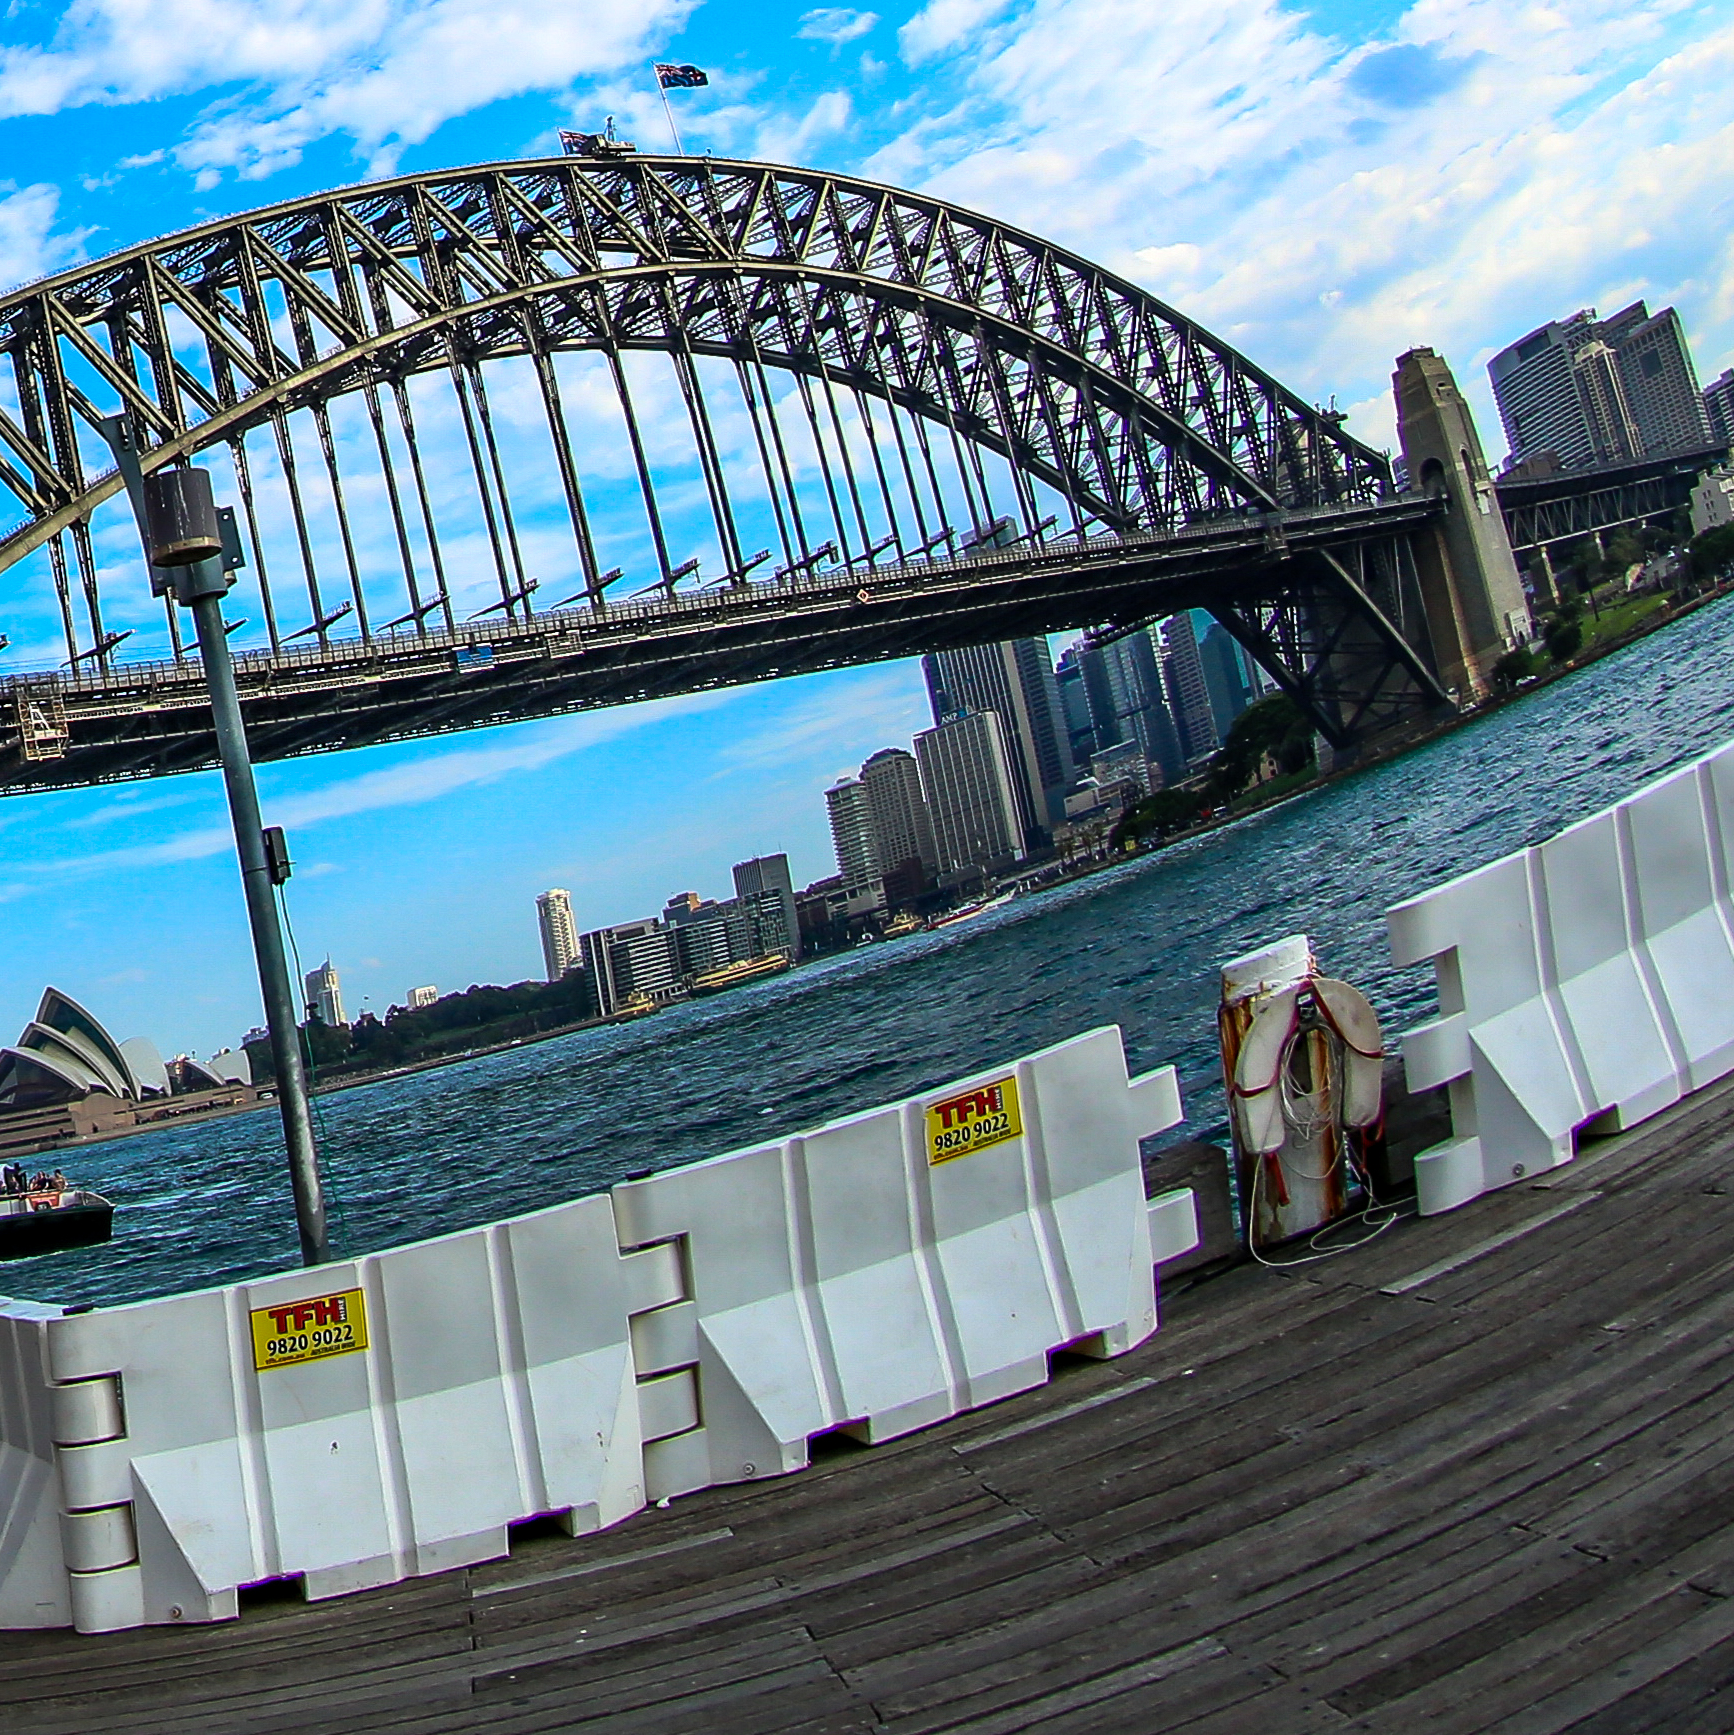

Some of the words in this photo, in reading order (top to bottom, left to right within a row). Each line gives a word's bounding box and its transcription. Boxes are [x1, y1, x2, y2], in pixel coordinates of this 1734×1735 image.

[935, 1087, 998, 1128] TFH
[934, 1126, 970, 1151] 9820
[973, 1113, 1009, 1138] 9022
[268, 1297, 340, 1334] TFH
[337, 1298, 346, 1321] HIRE
[267, 1333, 308, 1357] 9820
[312, 1324, 353, 1347] 9022
